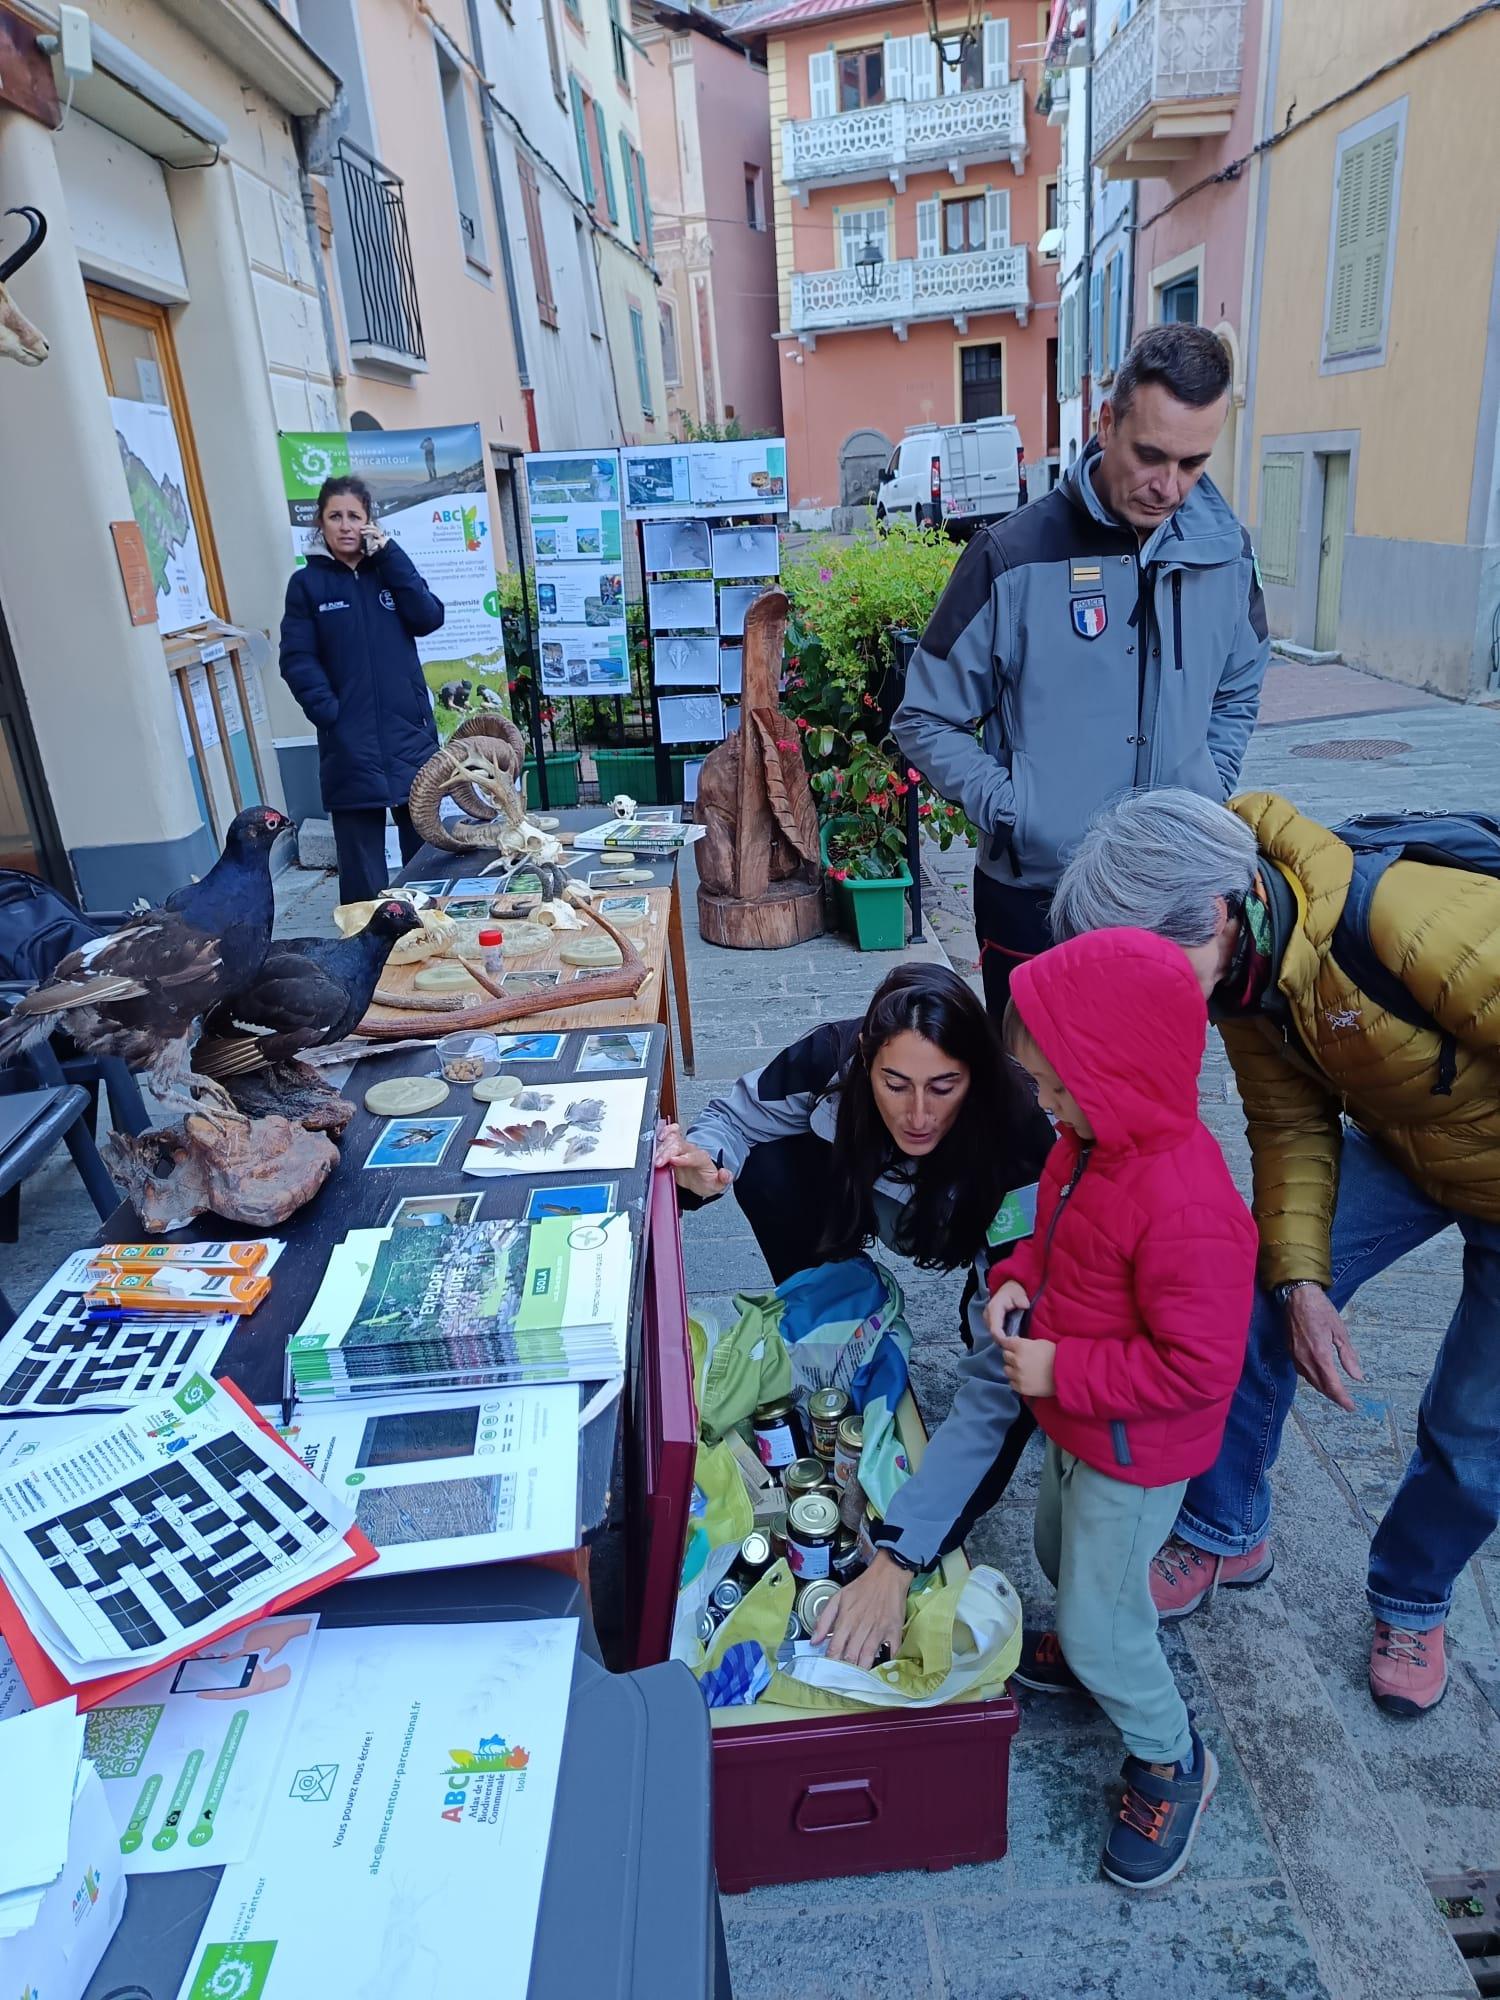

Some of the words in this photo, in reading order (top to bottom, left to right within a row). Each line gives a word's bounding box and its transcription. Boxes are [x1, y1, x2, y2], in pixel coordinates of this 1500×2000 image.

[350, 454, 410, 466] Mercantour
[351, 446, 385, 457] national
[432, 510, 462, 523] ABC
[488, 596, 496, 611] 1
[536, 1270, 548, 1295] ISOLA
[160, 1409, 178, 1422] ABC
[369, 1700, 422, 1876] abc@mercantour-parcnational.fr
[474, 1784, 482, 1795] de
[477, 1774, 485, 1783] la
[516, 1772, 527, 1793] Isola
[333, 1823, 348, 1848] Vous
[342, 1785, 359, 1821] pouvez
[354, 1761, 364, 1785] nous
[359, 1736, 372, 1762] écrire
[440, 1774, 470, 1824] ABC
[478, 1773, 495, 1824] Biodiversité
[488, 1772, 505, 1824] Communale
[468, 1794, 479, 1818] Atlas
[160, 1836, 170, 1844] 2
[196, 1832, 206, 1840] 3
[72, 1880, 86, 1914] ABC
[238, 1876, 266, 1940] Mercantour
[230, 1902, 248, 1940] national
